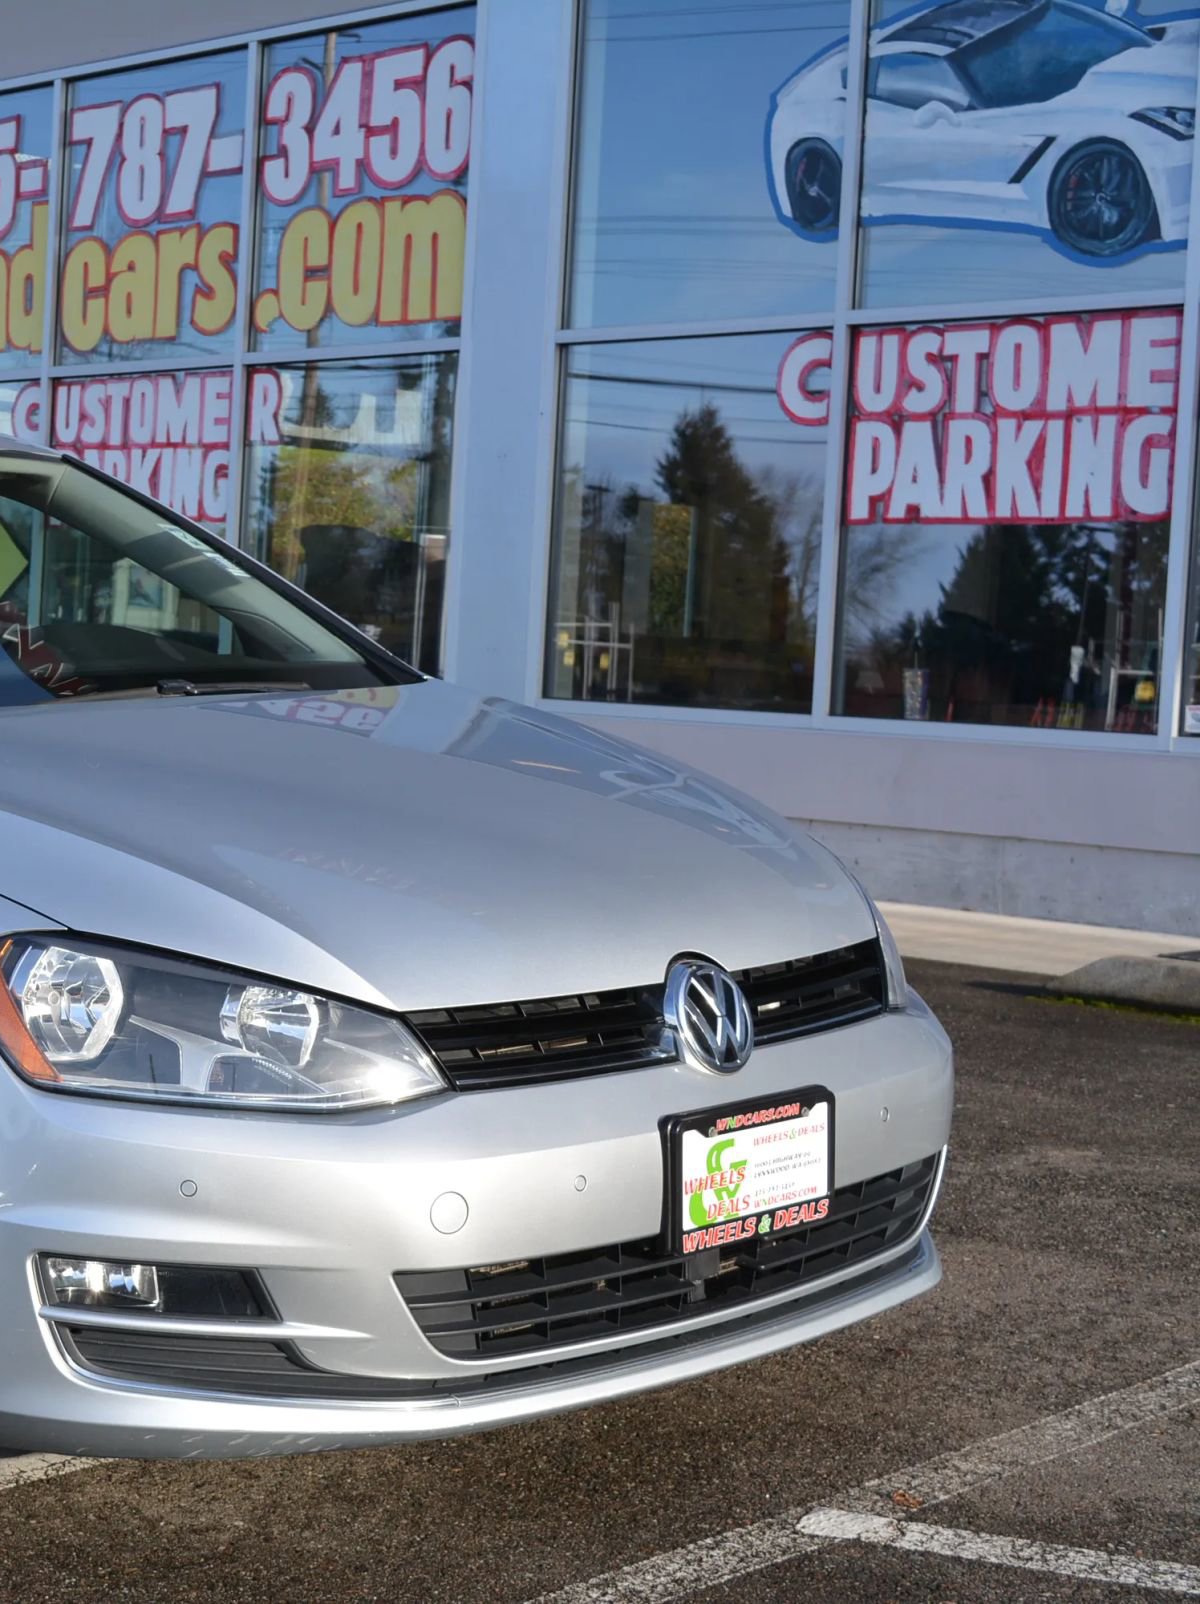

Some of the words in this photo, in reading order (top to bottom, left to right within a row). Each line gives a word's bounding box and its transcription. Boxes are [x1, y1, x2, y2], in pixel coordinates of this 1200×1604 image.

[846, 411, 1176, 526] PARKING
[716, 1103, 801, 1131] WNDCARS.COM
[753, 1130, 789, 1147] WHEELS
[684, 1166, 747, 1196] WHEELS
[707, 1193, 752, 1220] DEALS
[682, 1216, 758, 1254] WHEELS
[757, 1213, 772, 1234] &
[772, 1198, 830, 1231] DEALS
